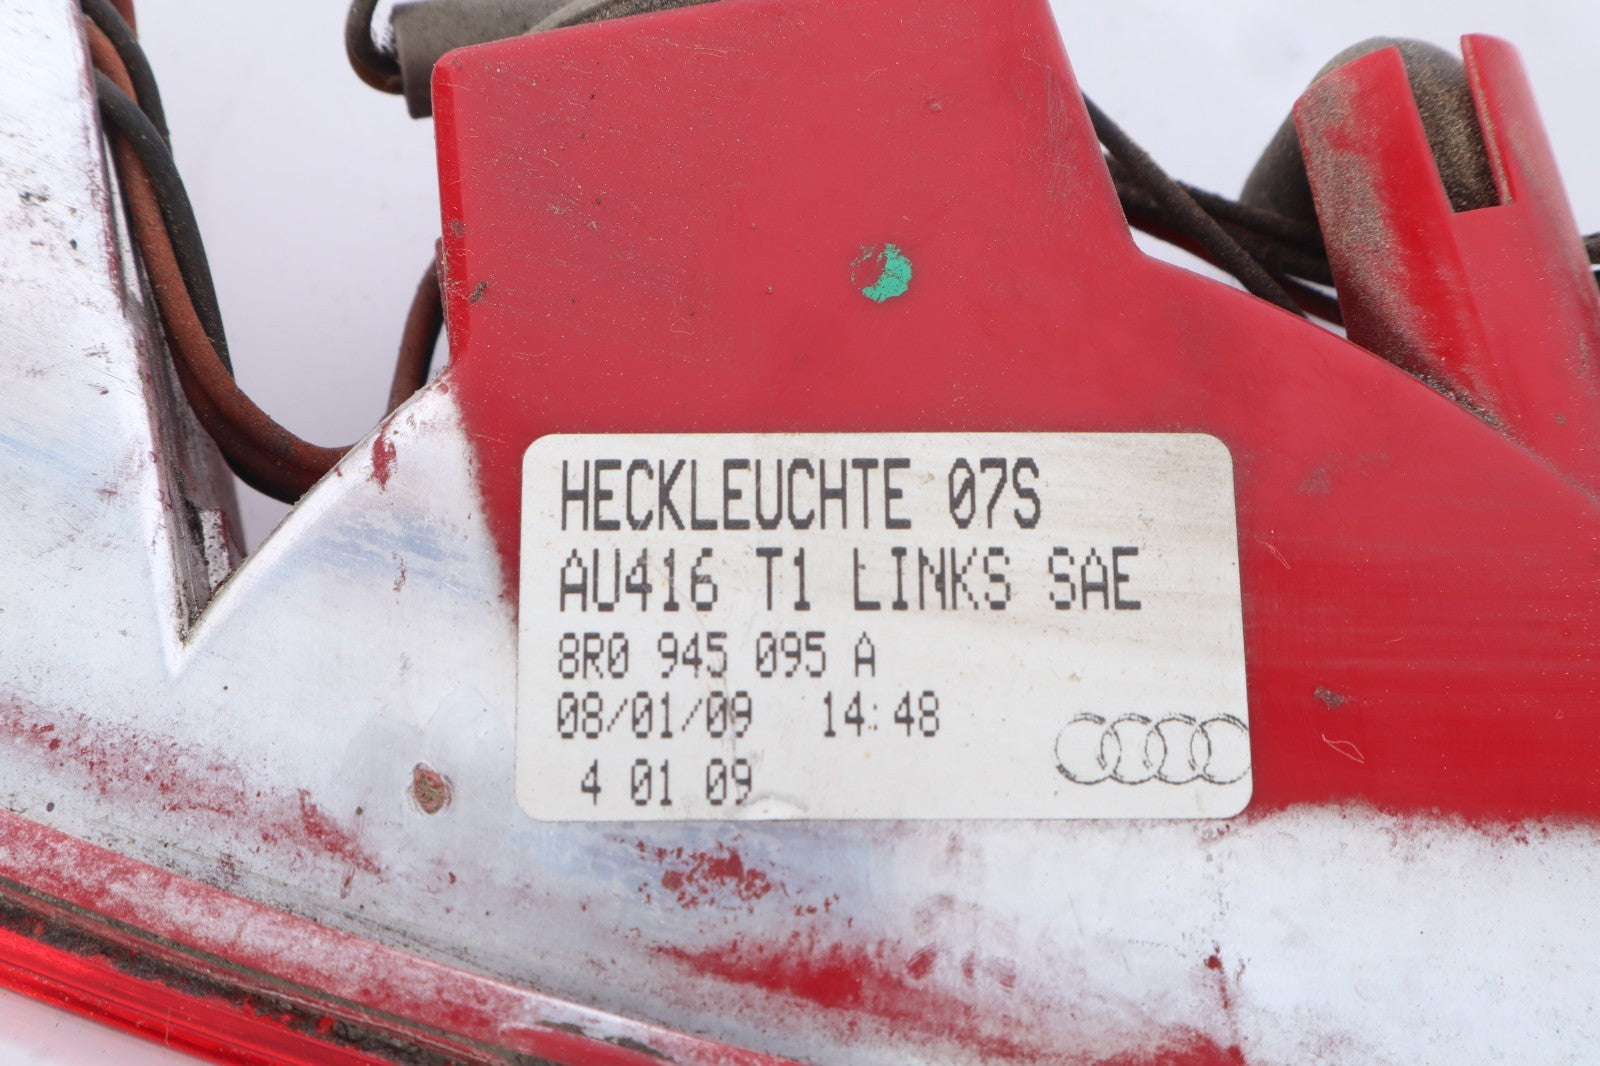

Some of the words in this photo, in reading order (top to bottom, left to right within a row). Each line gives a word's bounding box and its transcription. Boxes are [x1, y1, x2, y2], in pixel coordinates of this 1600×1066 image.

[561, 458, 912, 531] HECKLEUCHTE
[948, 457, 1041, 529] 07S
[560, 548, 718, 612] AU416
[756, 547, 810, 611] T1
[853, 547, 1011, 611] LINKS
[1048, 546, 1141, 610] SAE
[557, 632, 630, 679] 8R0
[658, 632, 727, 678] 945
[756, 631, 826, 678] 095
[854, 631, 876, 678] A
[557, 691, 752, 739] 08/01/09
[580, 758, 602, 806] 4
[631, 758, 672, 806] 01
[706, 758, 752, 806] 09
